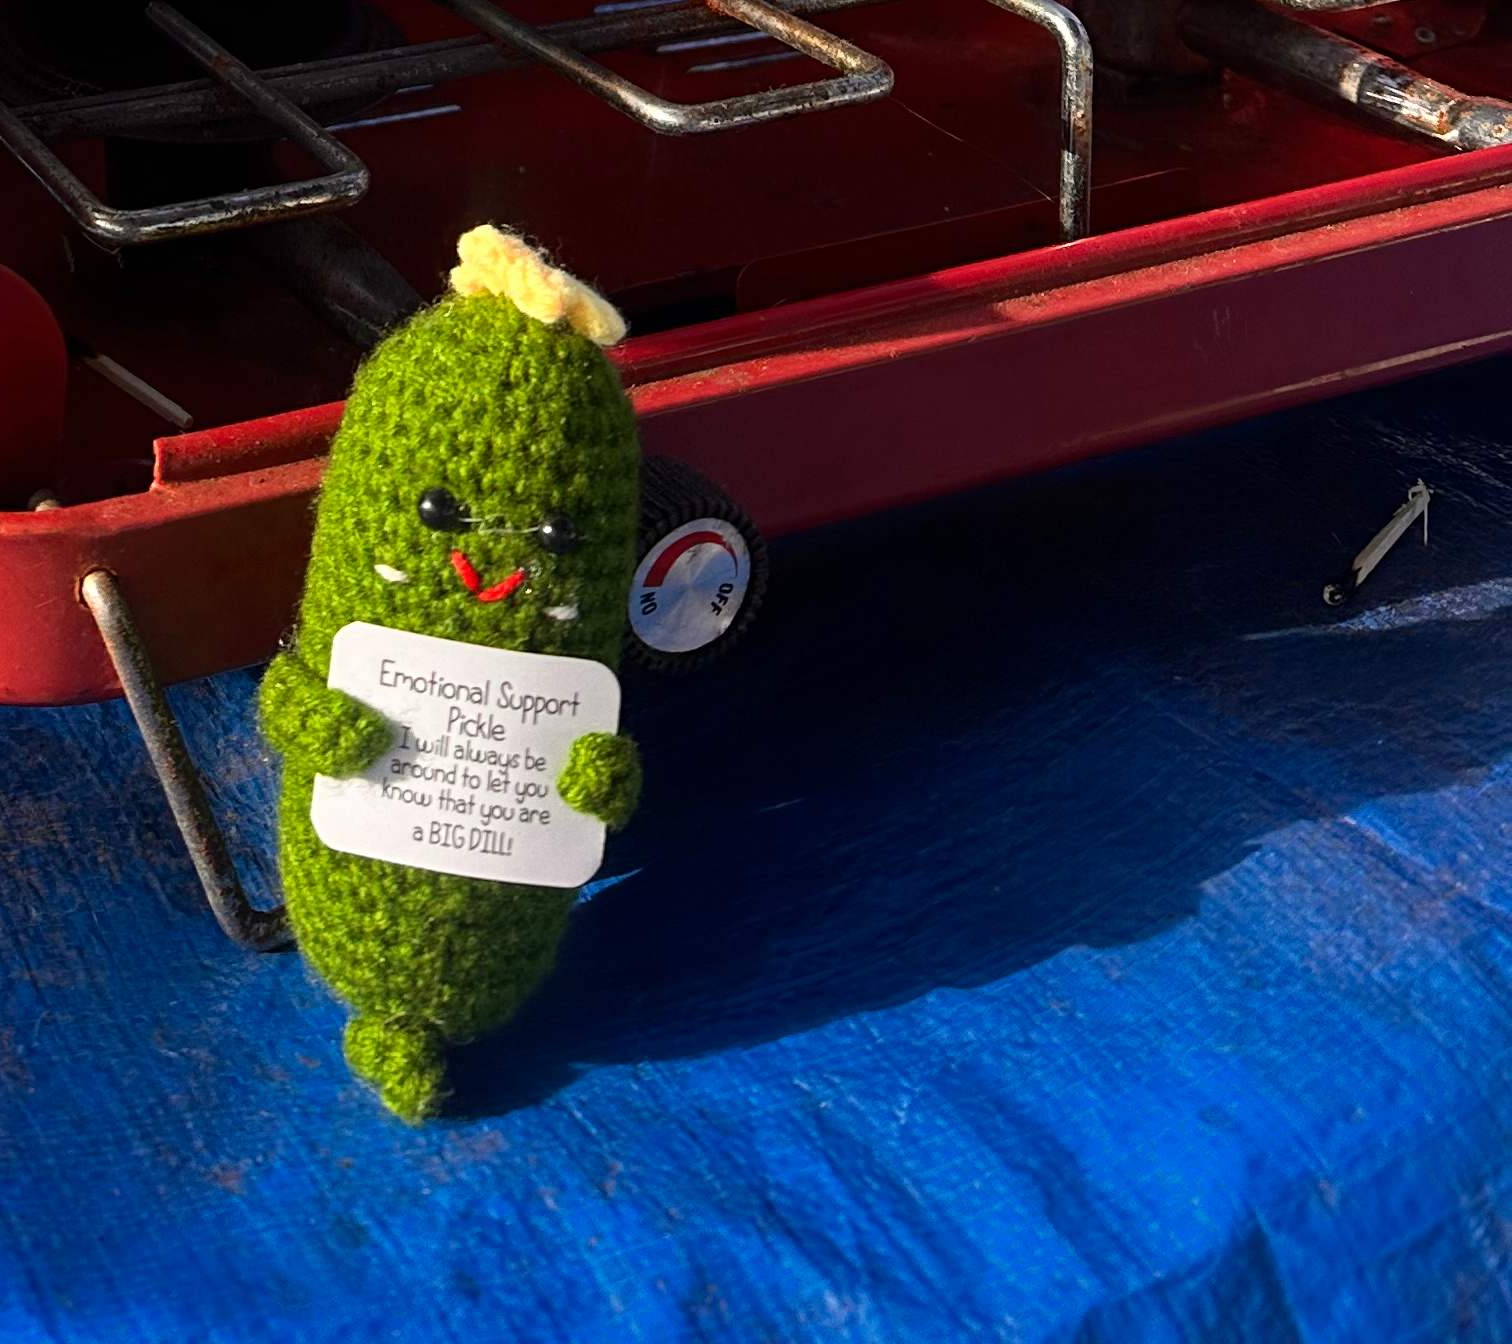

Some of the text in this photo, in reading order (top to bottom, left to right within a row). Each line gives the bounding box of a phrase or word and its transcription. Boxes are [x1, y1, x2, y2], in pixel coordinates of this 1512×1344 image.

[639, 590, 657, 616] ON
[710, 581, 734, 617] OFF
[379, 658, 582, 726] Emotional Support
[446, 705, 507, 742] Pickle
[398, 725, 548, 775] I will always be
[380, 776, 551, 826] know that you are
[390, 757, 550, 804] around to let you
[412, 820, 515, 857] a BIG DILL!
